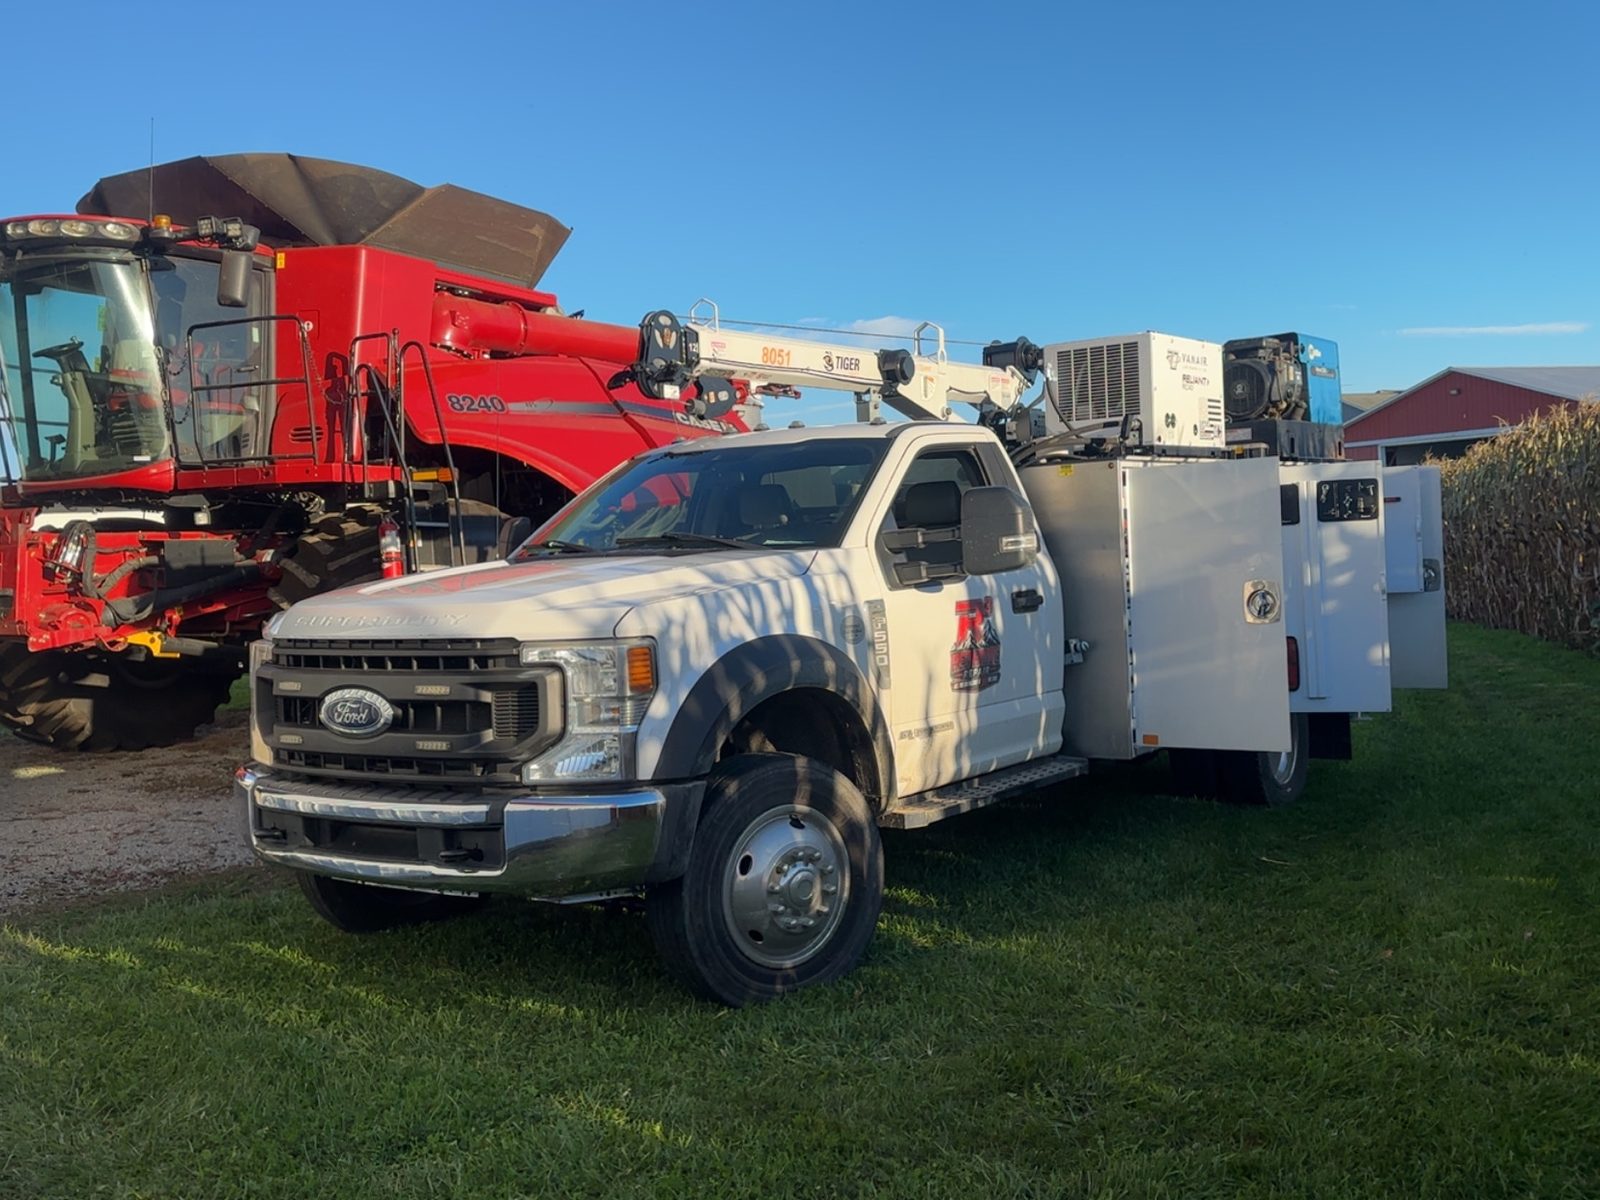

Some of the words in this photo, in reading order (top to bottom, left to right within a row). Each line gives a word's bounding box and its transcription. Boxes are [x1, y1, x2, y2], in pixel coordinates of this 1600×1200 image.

[761, 346, 791, 367] 8051
[835, 356, 860, 371] TIGER
[446, 395, 506, 412] 8240
[334, 702, 369, 724] Ford
